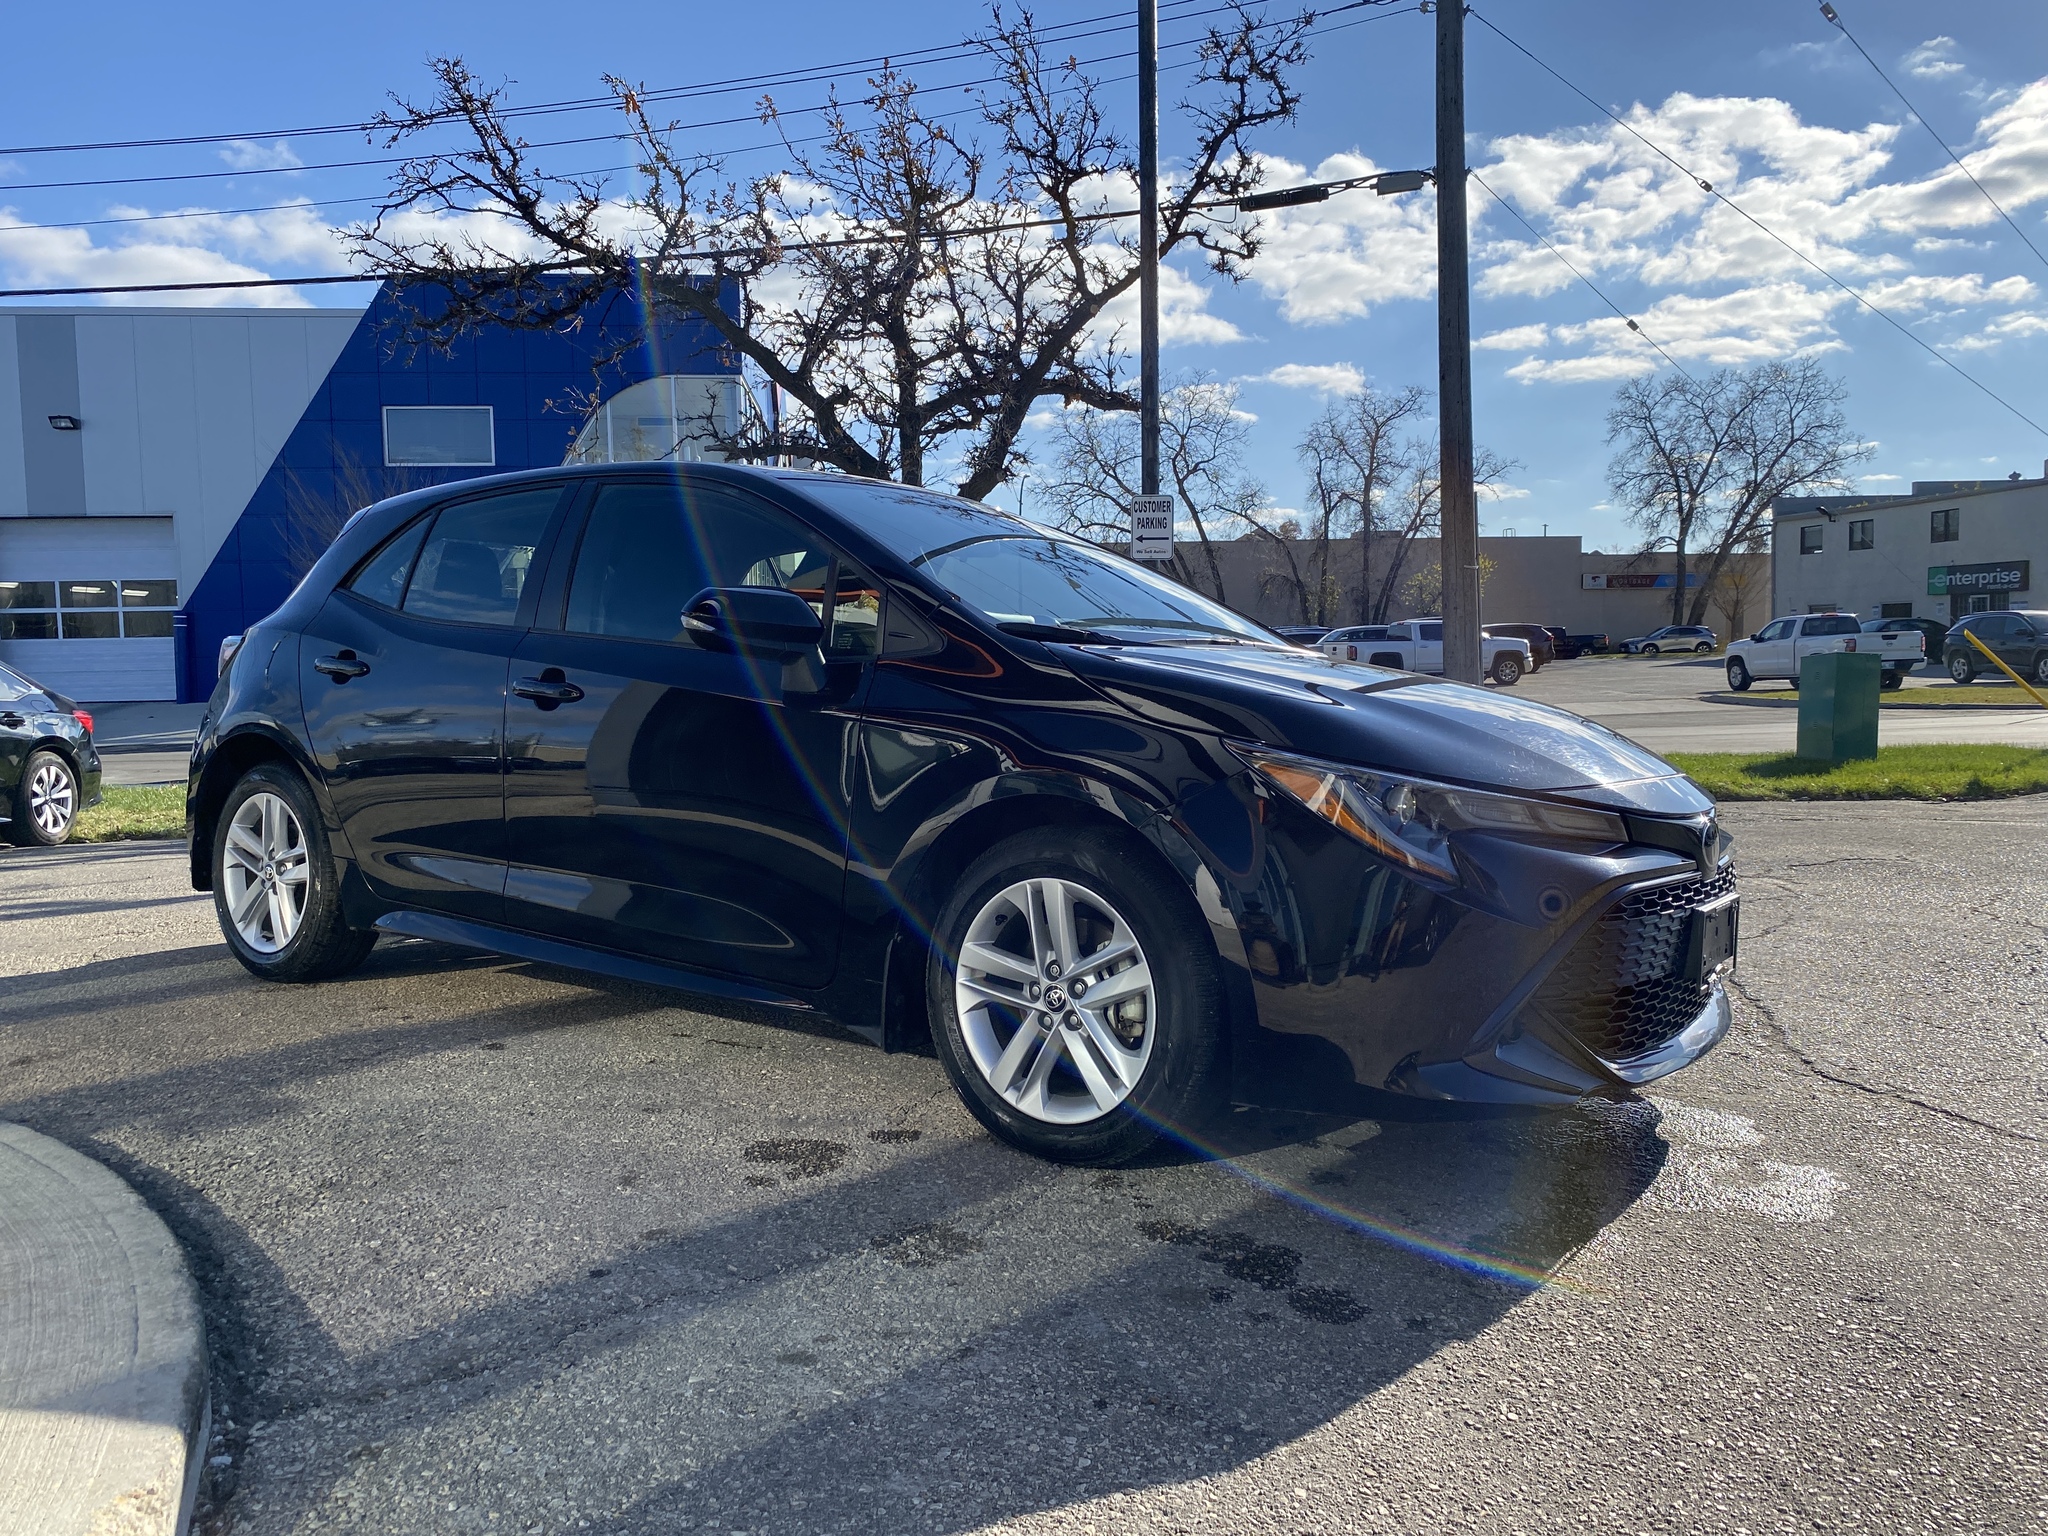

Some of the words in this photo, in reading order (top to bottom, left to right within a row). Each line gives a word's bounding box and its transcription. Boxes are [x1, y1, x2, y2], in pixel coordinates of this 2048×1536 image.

[1133, 501, 1171, 513] CUSTOMER
[1137, 517, 1167, 529] PARKING
[1930, 568, 2021, 588] enterprise
